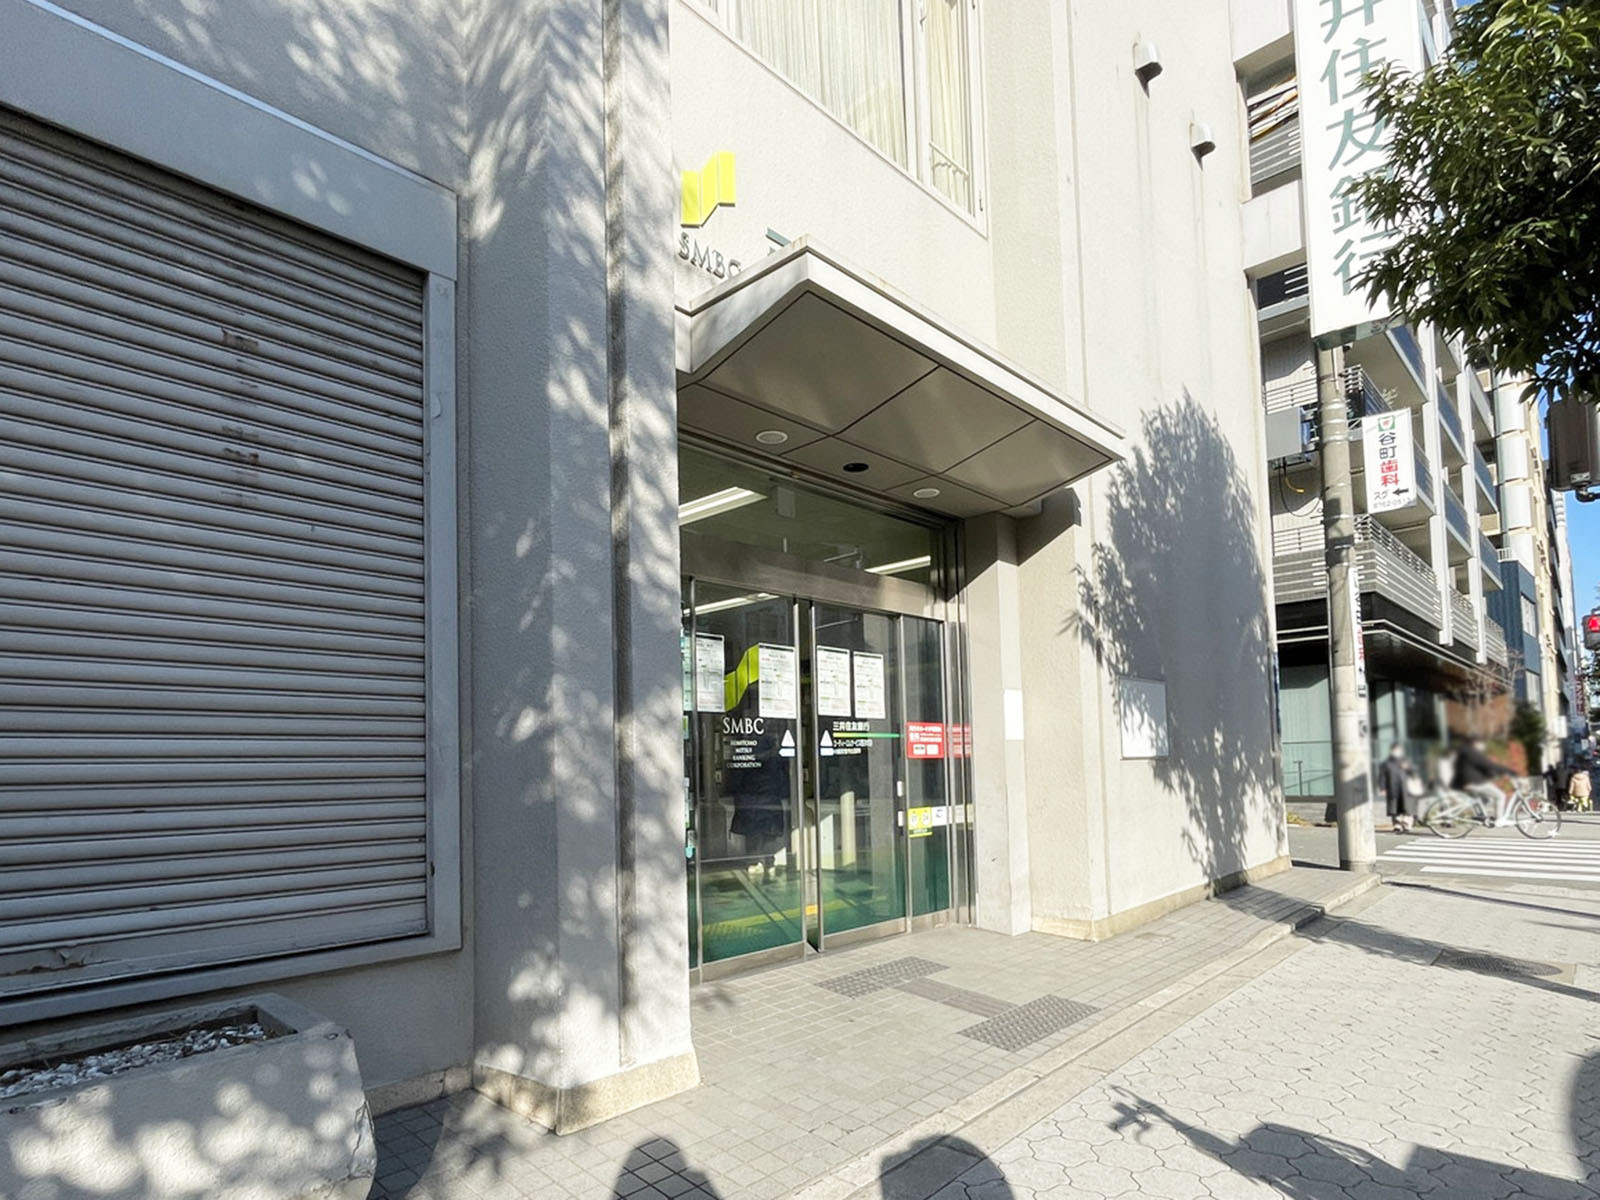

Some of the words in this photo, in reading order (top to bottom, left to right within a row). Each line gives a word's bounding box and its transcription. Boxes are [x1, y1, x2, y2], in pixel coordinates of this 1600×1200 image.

[678, 231, 742, 280] SMBC
[1378, 431, 1399, 487] 谷町歯科
[722, 717, 764, 735] SMBC
